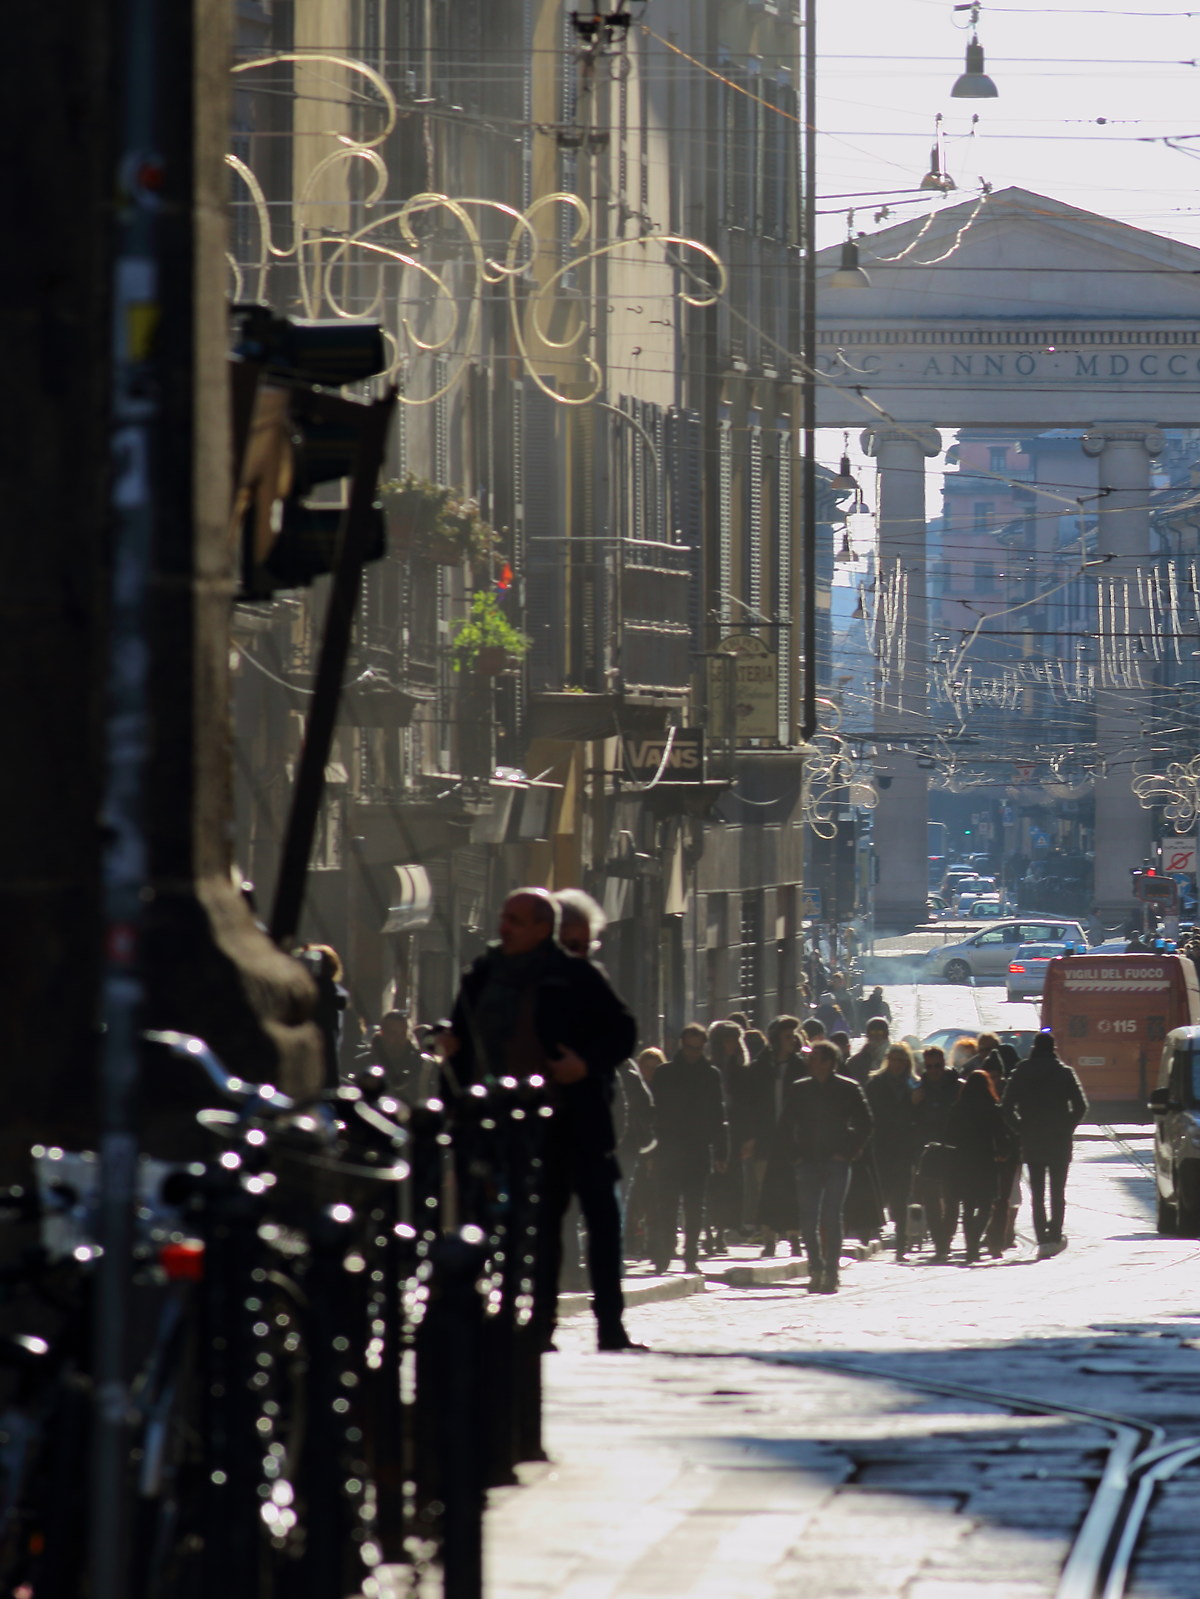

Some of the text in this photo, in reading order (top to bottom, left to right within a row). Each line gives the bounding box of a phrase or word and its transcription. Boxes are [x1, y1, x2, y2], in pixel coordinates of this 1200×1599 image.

[922, 354, 1036, 376] ANNO
[627, 740, 698, 768] VANS
[1064, 968, 1164, 979] VIGILI DEL FUOCO
[1113, 1020, 1137, 1032] 115
